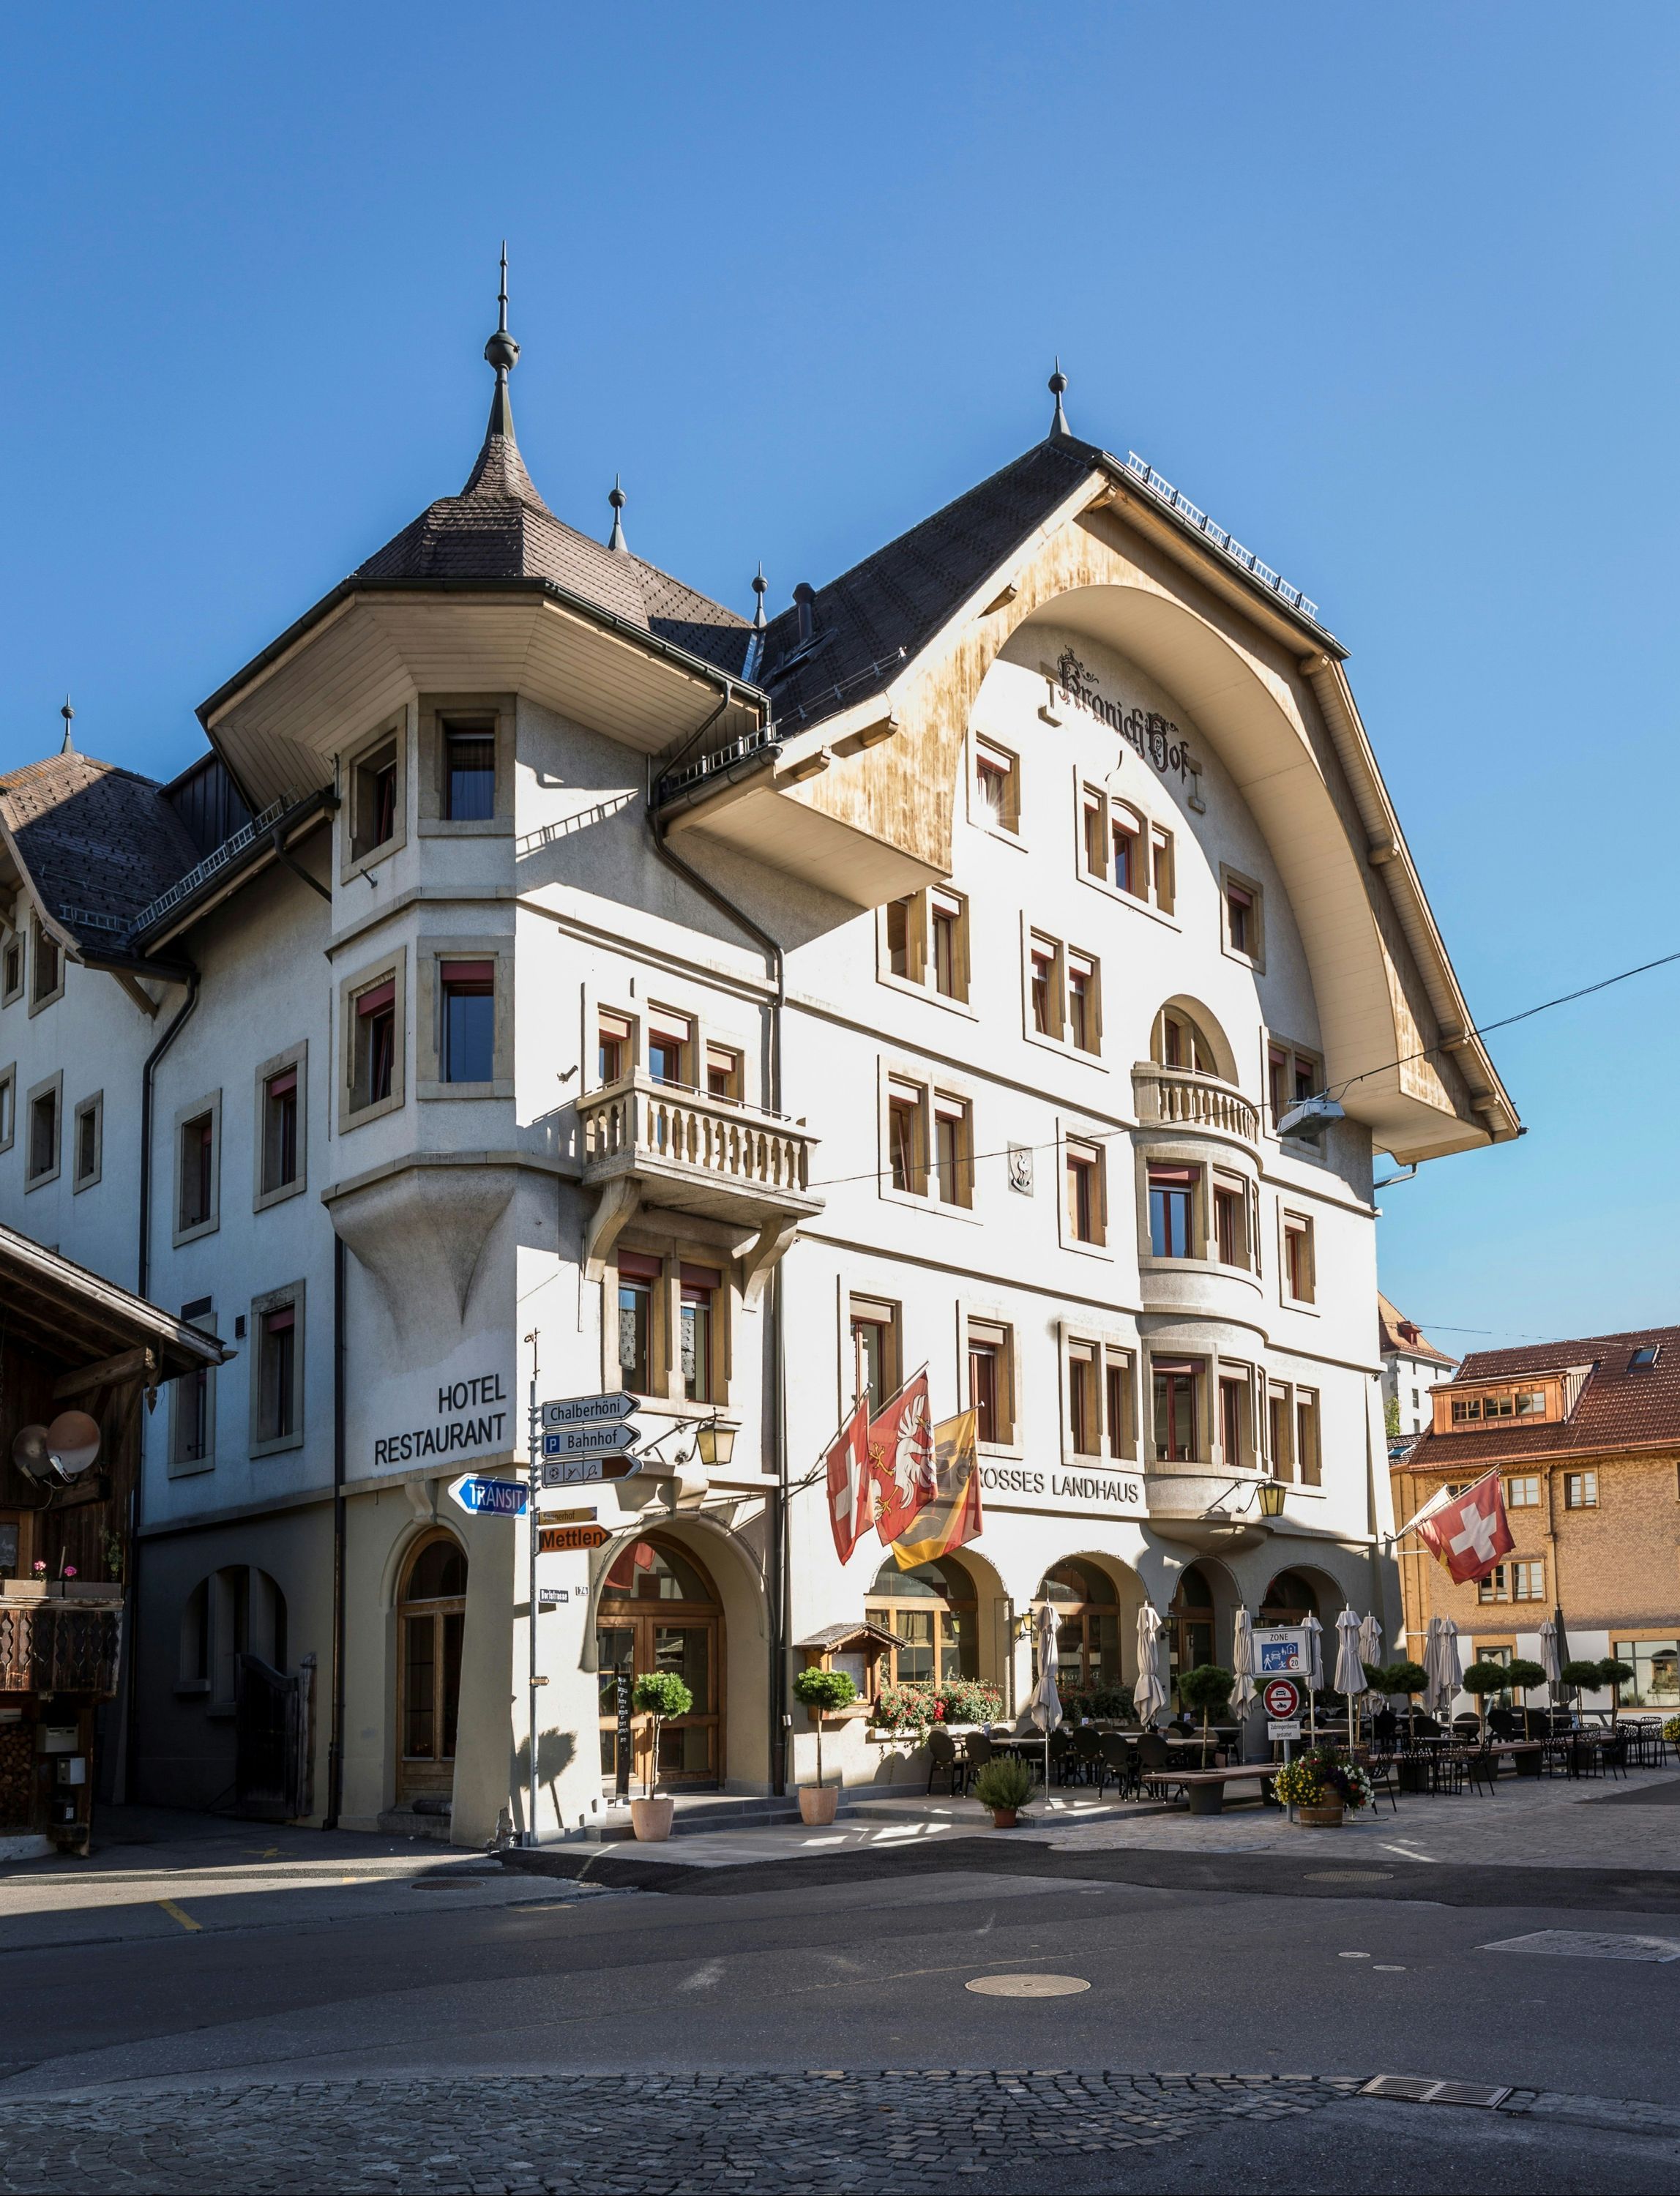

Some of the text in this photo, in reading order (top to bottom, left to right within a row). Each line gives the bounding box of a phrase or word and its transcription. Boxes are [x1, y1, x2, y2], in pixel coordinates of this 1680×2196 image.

[438, 1373, 507, 1413] HOTEL
[550, 1398, 621, 1421] Chalberhöni
[375, 1412, 507, 1466] RESTAURANT
[567, 1429, 618, 1449] Bahnhof
[468, 1483, 523, 1509] TRANSIT
[1052, 1474, 1139, 1504] LANDHAUS
[542, 1528, 603, 1549] Mettlen
[1269, 1633, 1288, 1642] ZONE
[1270, 1723, 1297, 1731] Zubringerdienst
